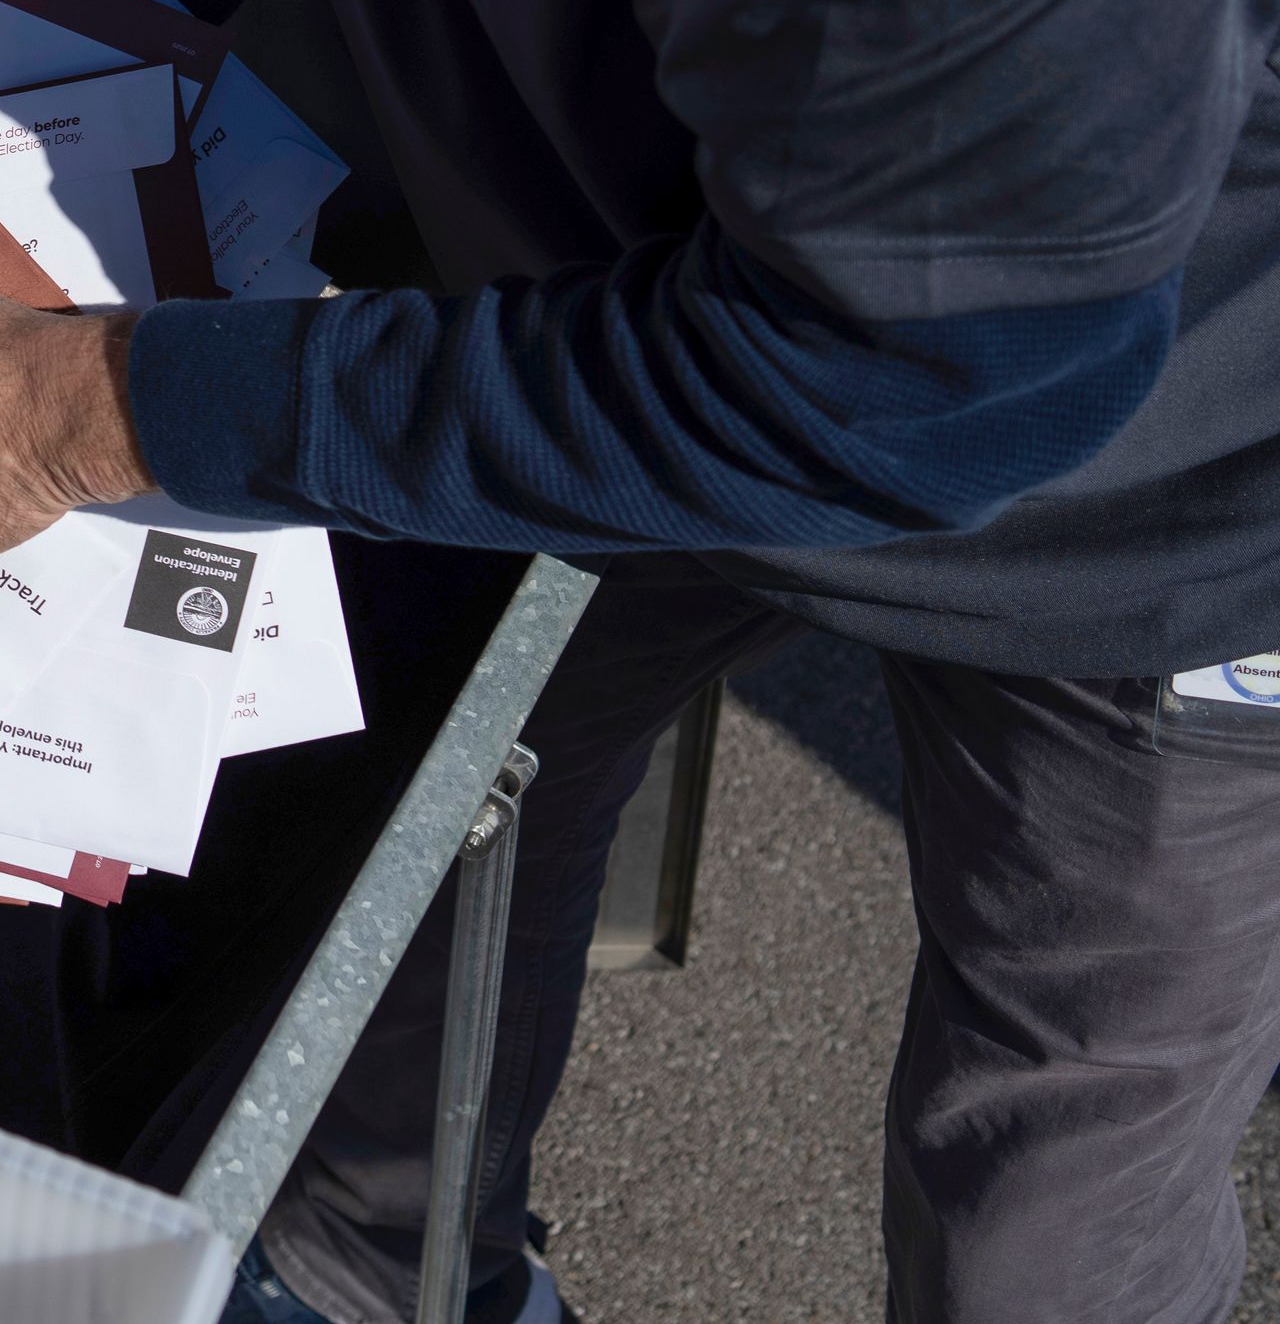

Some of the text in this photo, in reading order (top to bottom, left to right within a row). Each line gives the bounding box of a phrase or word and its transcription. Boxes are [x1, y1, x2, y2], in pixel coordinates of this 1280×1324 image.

[5, 126, 33, 144] day
[34, 117, 80, 135] before
[55, 132, 84, 145] Day.
[201, 127, 226, 157] Did
[209, 200, 248, 241] Election
[233, 212, 259, 237] Your
[154, 555, 237, 582] Identification
[184, 548, 241, 568] Envelope
[1249, 693, 1274, 703] OHIO
[55, 738, 83, 753] this
[13, 745, 92, 773] Important:
